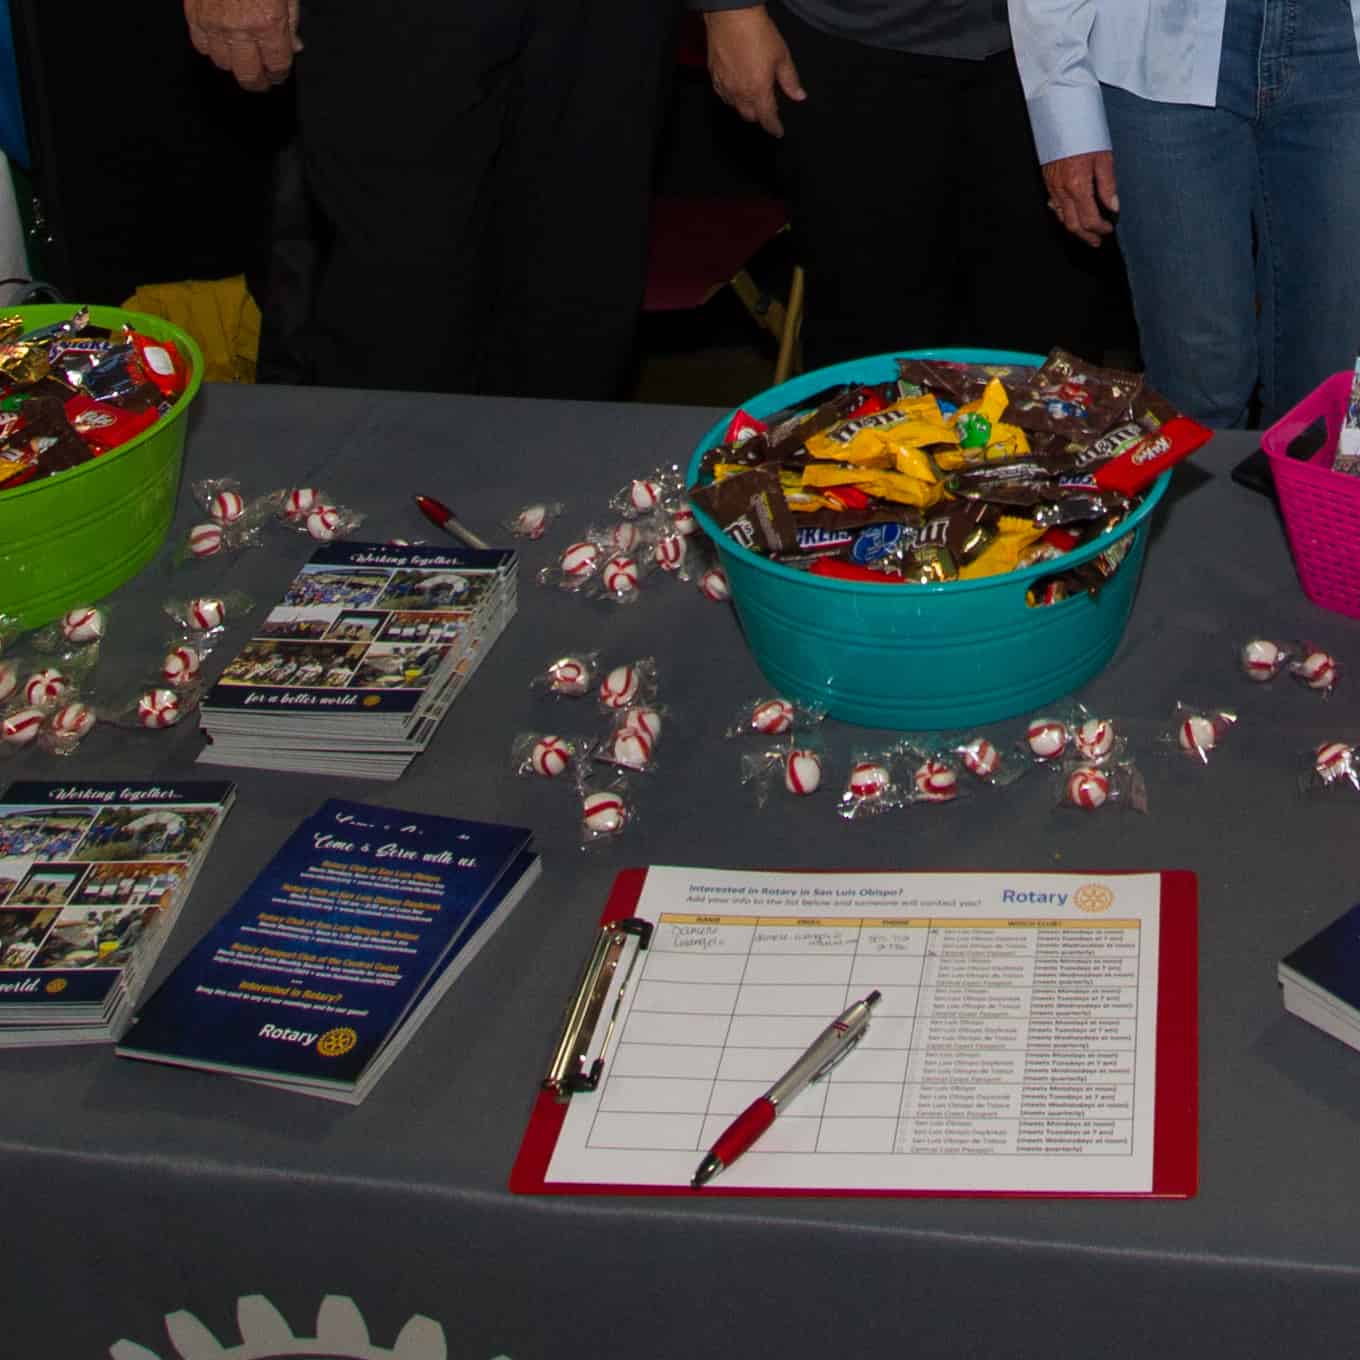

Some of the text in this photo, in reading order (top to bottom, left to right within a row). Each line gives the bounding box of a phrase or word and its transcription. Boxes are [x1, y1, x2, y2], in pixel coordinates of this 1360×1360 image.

[349, 552, 408, 567] Working
[243, 692, 265, 706] for
[280, 691, 318, 705] better
[48, 787, 114, 802] Working
[313, 831, 355, 853] Come
[375, 842, 417, 861] Serve
[422, 850, 454, 866] with
[688, 883, 903, 898] Interested in Rotary in San Luis Obispo?
[1001, 888, 1068, 906] Rotary
[258, 1021, 320, 1048] Rotary
